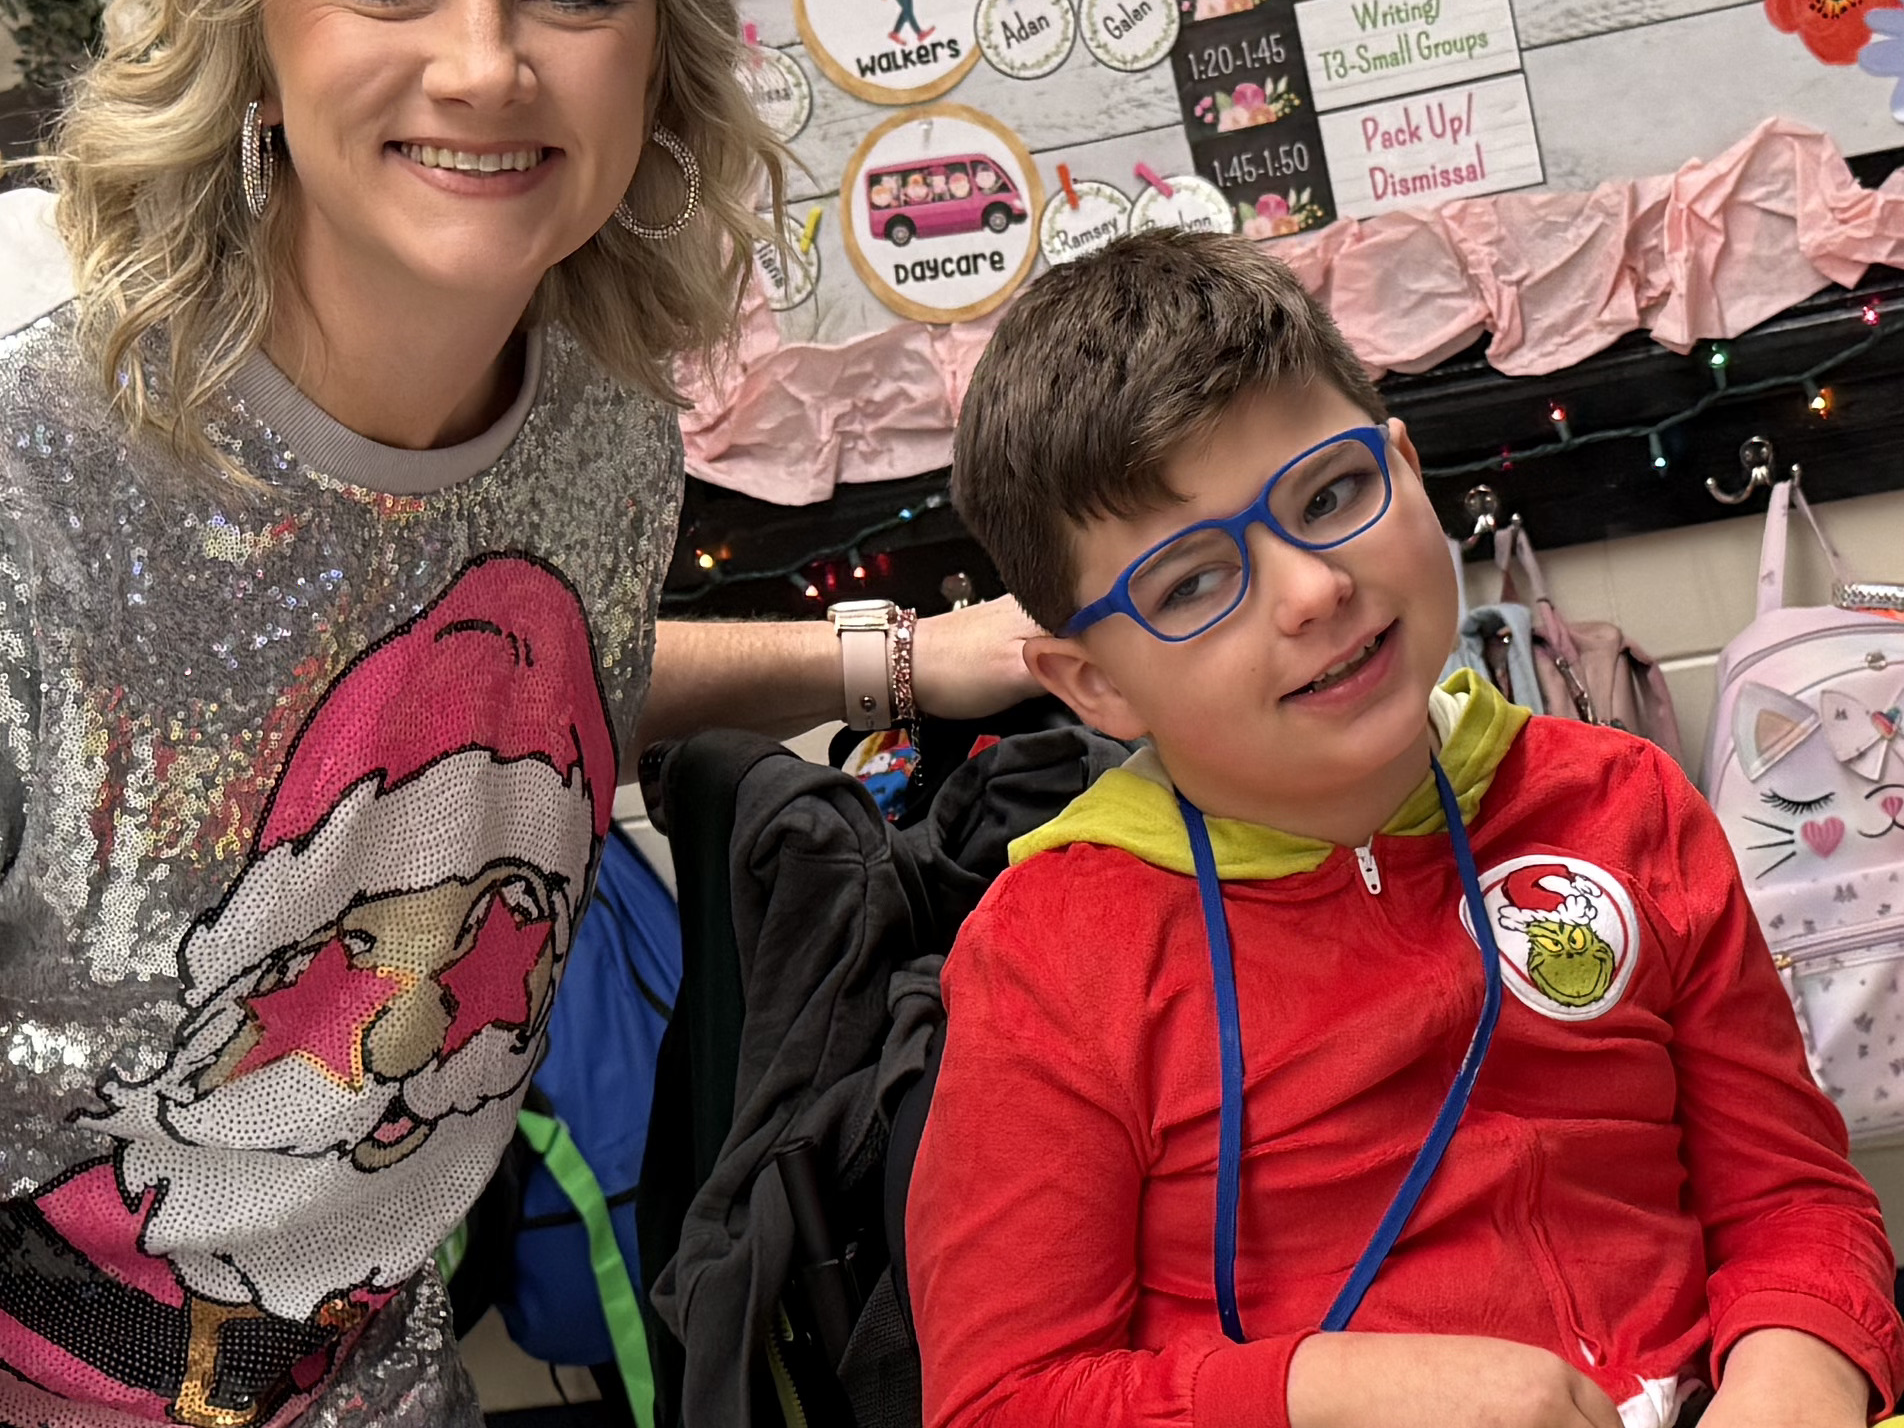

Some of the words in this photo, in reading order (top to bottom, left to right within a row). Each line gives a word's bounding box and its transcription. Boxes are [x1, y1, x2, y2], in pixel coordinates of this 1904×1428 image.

[1001, 11, 1052, 50] Adan
[1415, 31, 1489, 66] Groups
[1188, 33, 1287, 81] 1:20-1:45
[1361, 106, 1422, 152] Pack
[1426, 92, 1473, 145] Up/
[1212, 143, 1310, 188] 1:45-1:50
[1369, 142, 1486, 201] Dismissal
